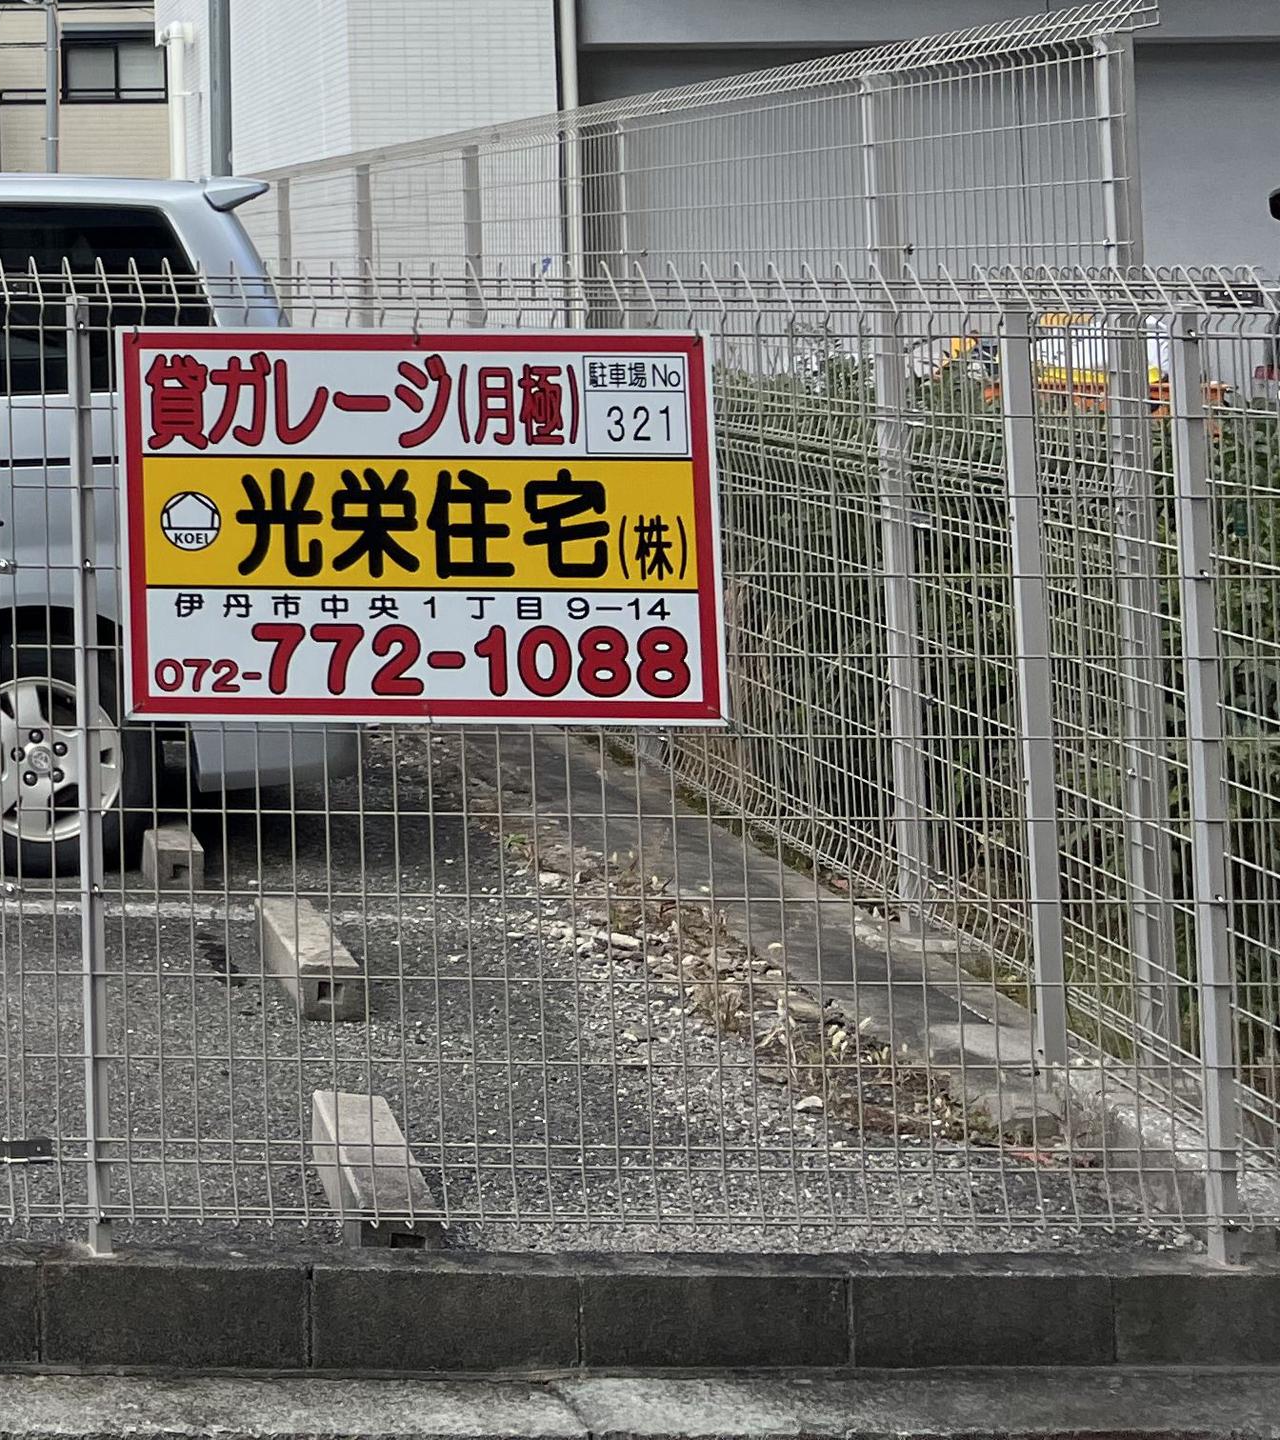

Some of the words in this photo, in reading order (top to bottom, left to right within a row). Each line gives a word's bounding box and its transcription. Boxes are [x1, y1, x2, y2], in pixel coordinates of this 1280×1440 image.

[144, 351, 581, 449] 貸ガレージ(月極)
[605, 404, 674, 444] 321
[174, 532, 209, 545] KOEI
[236, 467, 688, 583] 光栄住宅(株)
[153, 622, 691, 698] 072-772-1088
